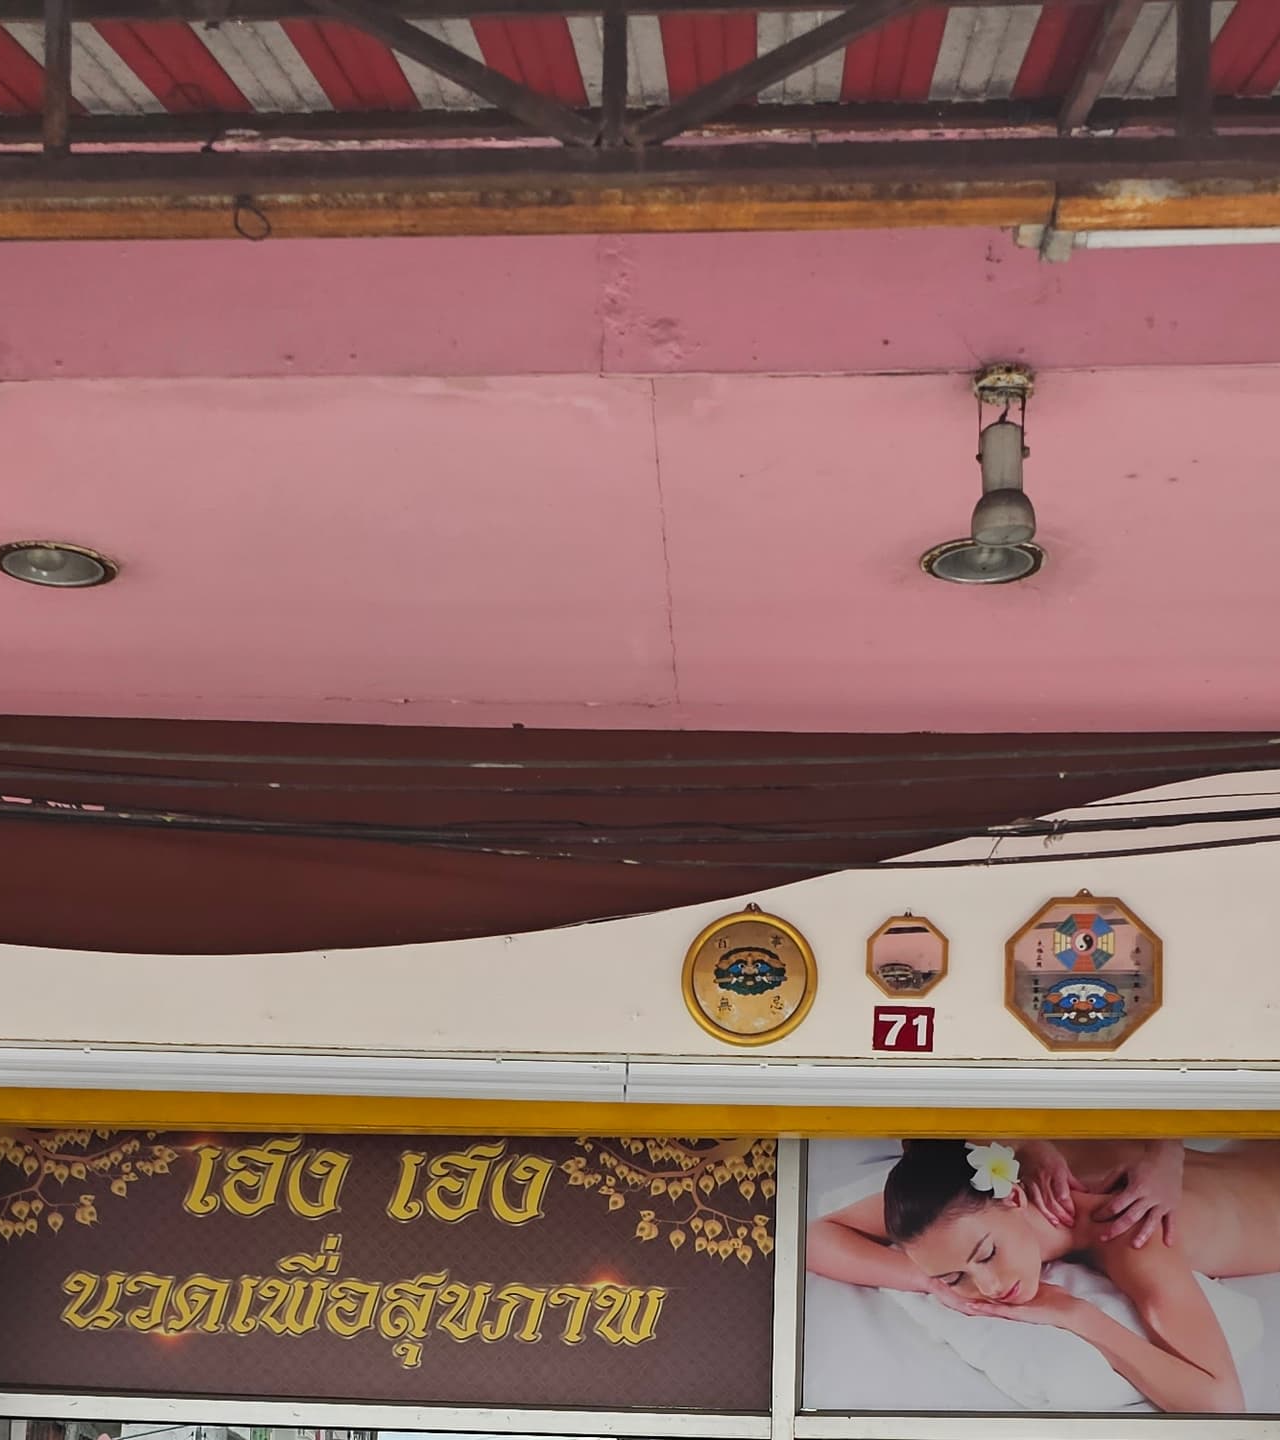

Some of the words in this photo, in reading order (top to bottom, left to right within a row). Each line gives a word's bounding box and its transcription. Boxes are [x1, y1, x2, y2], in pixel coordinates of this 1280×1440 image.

[879, 1014, 927, 1046] 71
[180, 1134, 351, 1219] เฮง
[384, 1140, 557, 1225] เฮง
[60, 1233, 667, 1371] นวดเพื่อสุขภาพ
